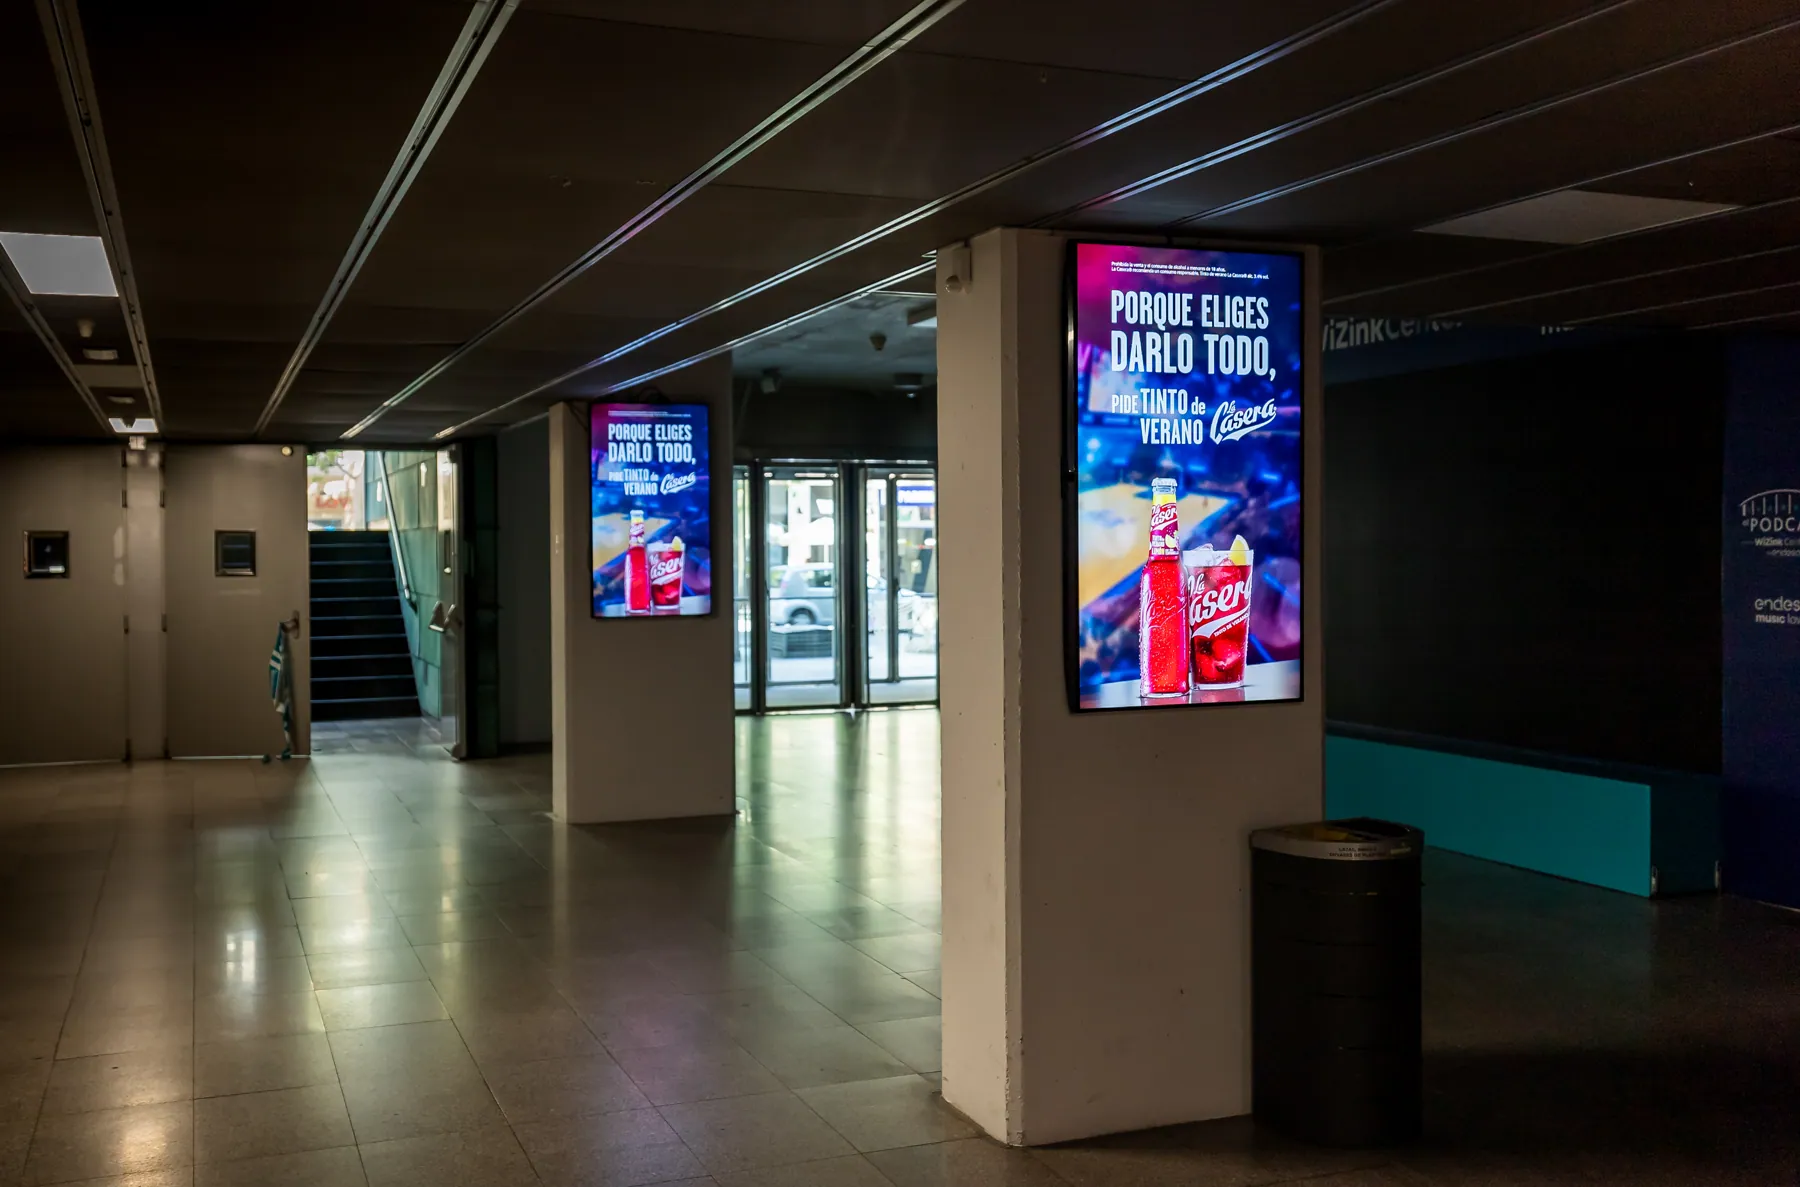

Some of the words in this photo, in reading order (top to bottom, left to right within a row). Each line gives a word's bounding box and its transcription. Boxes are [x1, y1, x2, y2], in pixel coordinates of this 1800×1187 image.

[1111, 289, 1193, 331] PORQUE
[1201, 294, 1269, 330] ELIGES
[1111, 330, 1194, 374] DARLO
[1203, 333, 1276, 382] TODO,
[1111, 394, 1139, 414] PIDE
[1140, 387, 1188, 416] TINTO
[1191, 396, 1206, 415] de
[608, 423, 652, 443] PORQUE
[655, 424, 693, 441] ELIGES
[1140, 418, 1204, 445] VERANO
[1209, 398, 1277, 445] Casera
[608, 442, 653, 463] DARLO
[656, 442, 697, 466] TODO,
[624, 468, 650, 482] TINTO
[624, 482, 659, 496] VERANO
[1755, 614, 1785, 624] music
